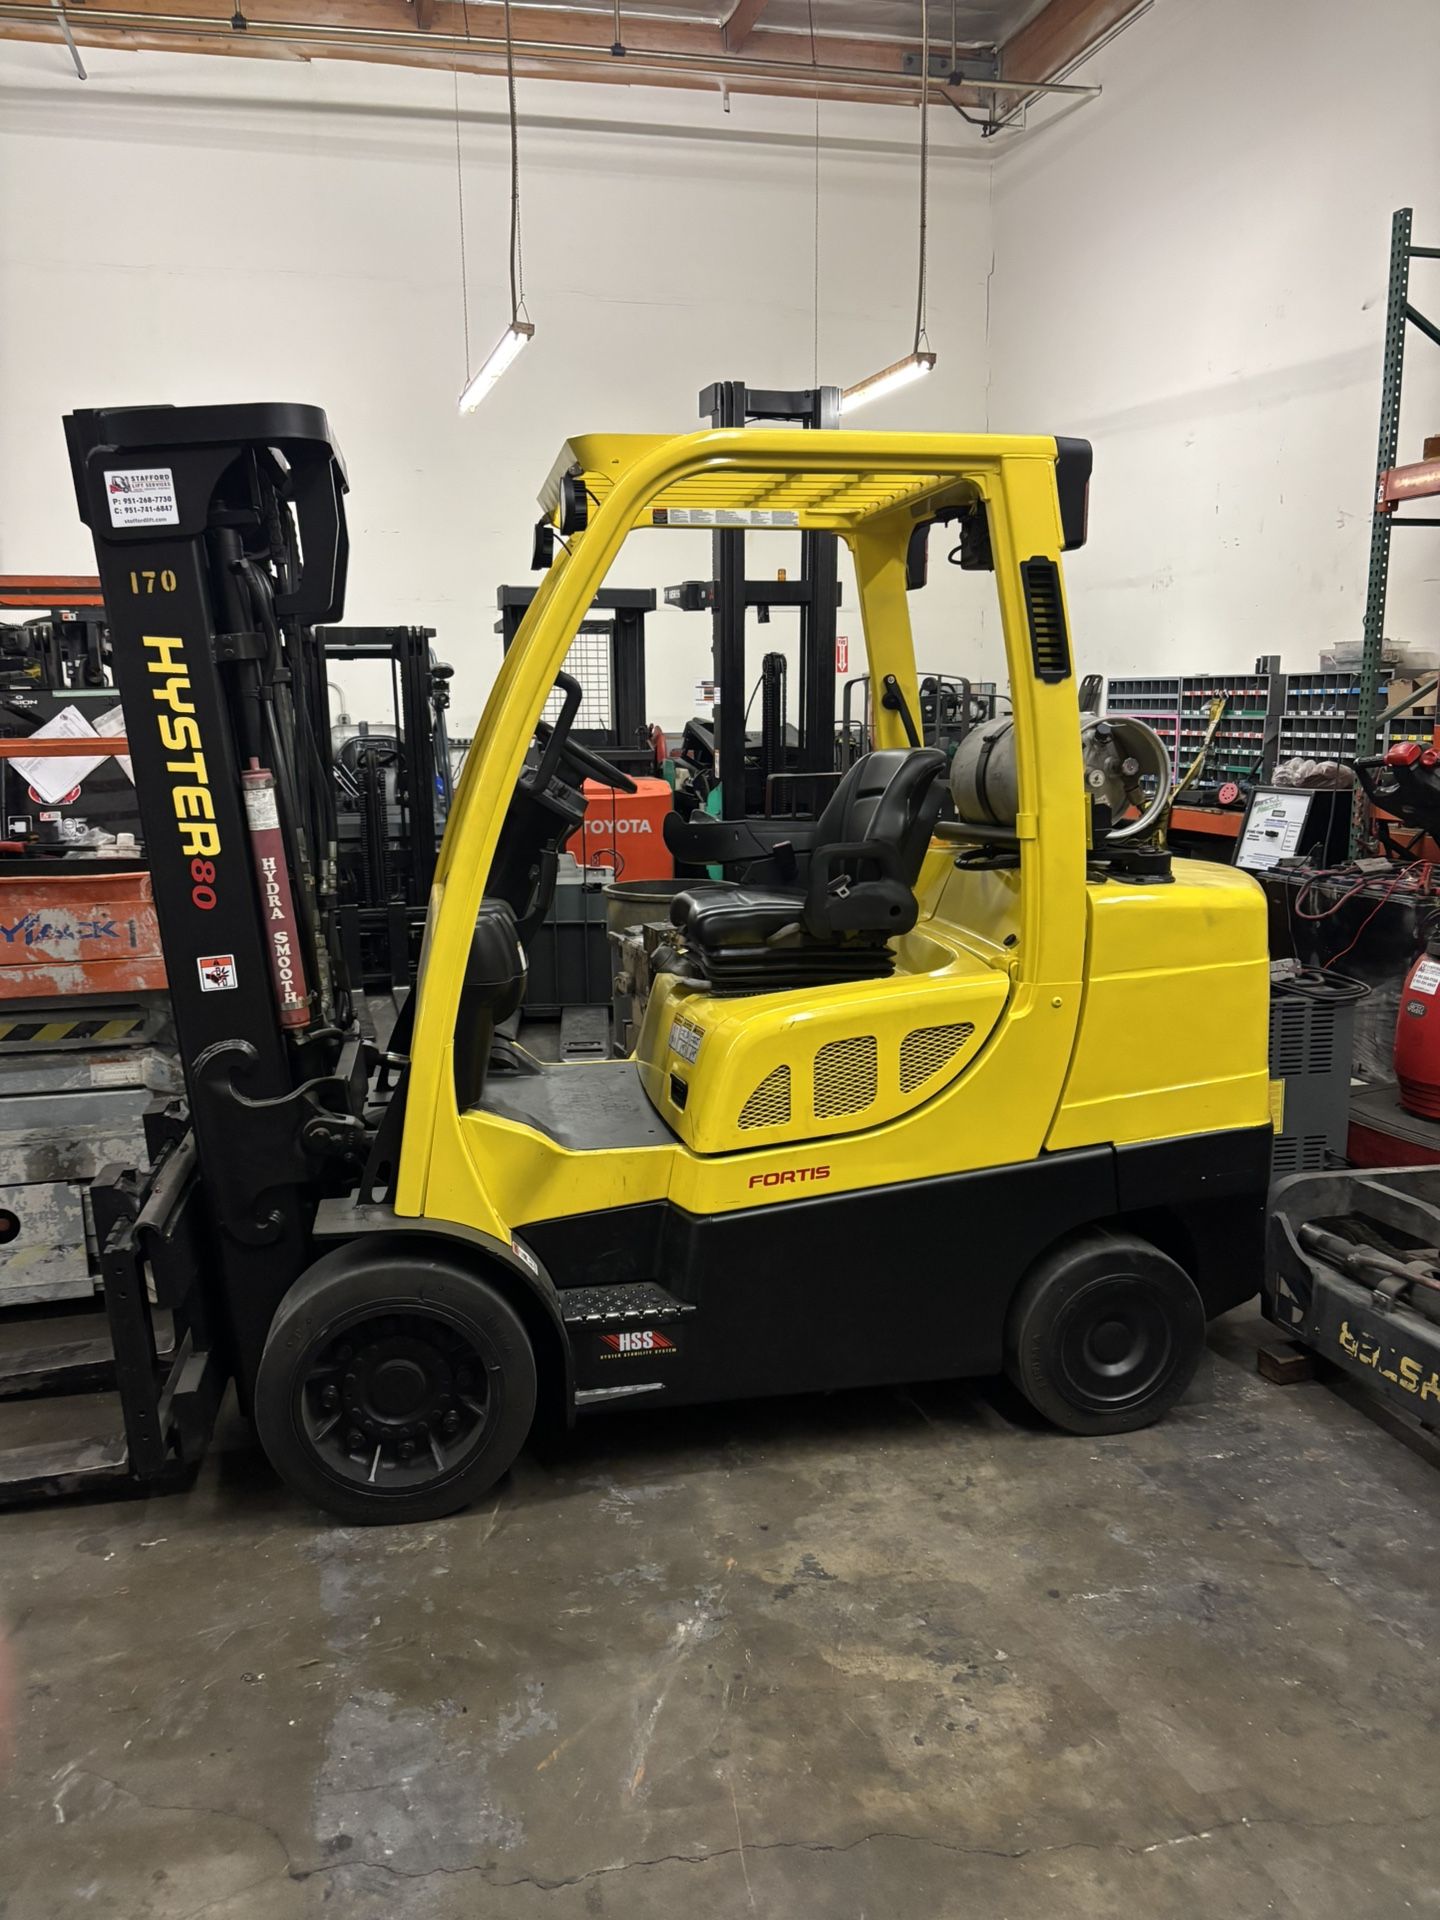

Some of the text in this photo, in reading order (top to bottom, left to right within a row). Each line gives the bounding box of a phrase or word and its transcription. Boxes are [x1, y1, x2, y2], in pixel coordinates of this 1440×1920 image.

[131, 474, 170, 482] STAFFORD
[129, 570, 178, 594] 170
[142, 635, 222, 911] HYSTER 80
[583, 819, 652, 834] TOYOTA
[261, 857, 286, 920] HYDRA
[273, 931, 298, 1004] SMOOTH
[748, 1165, 831, 1189] FORTIS
[619, 1330, 654, 1352] HSS
